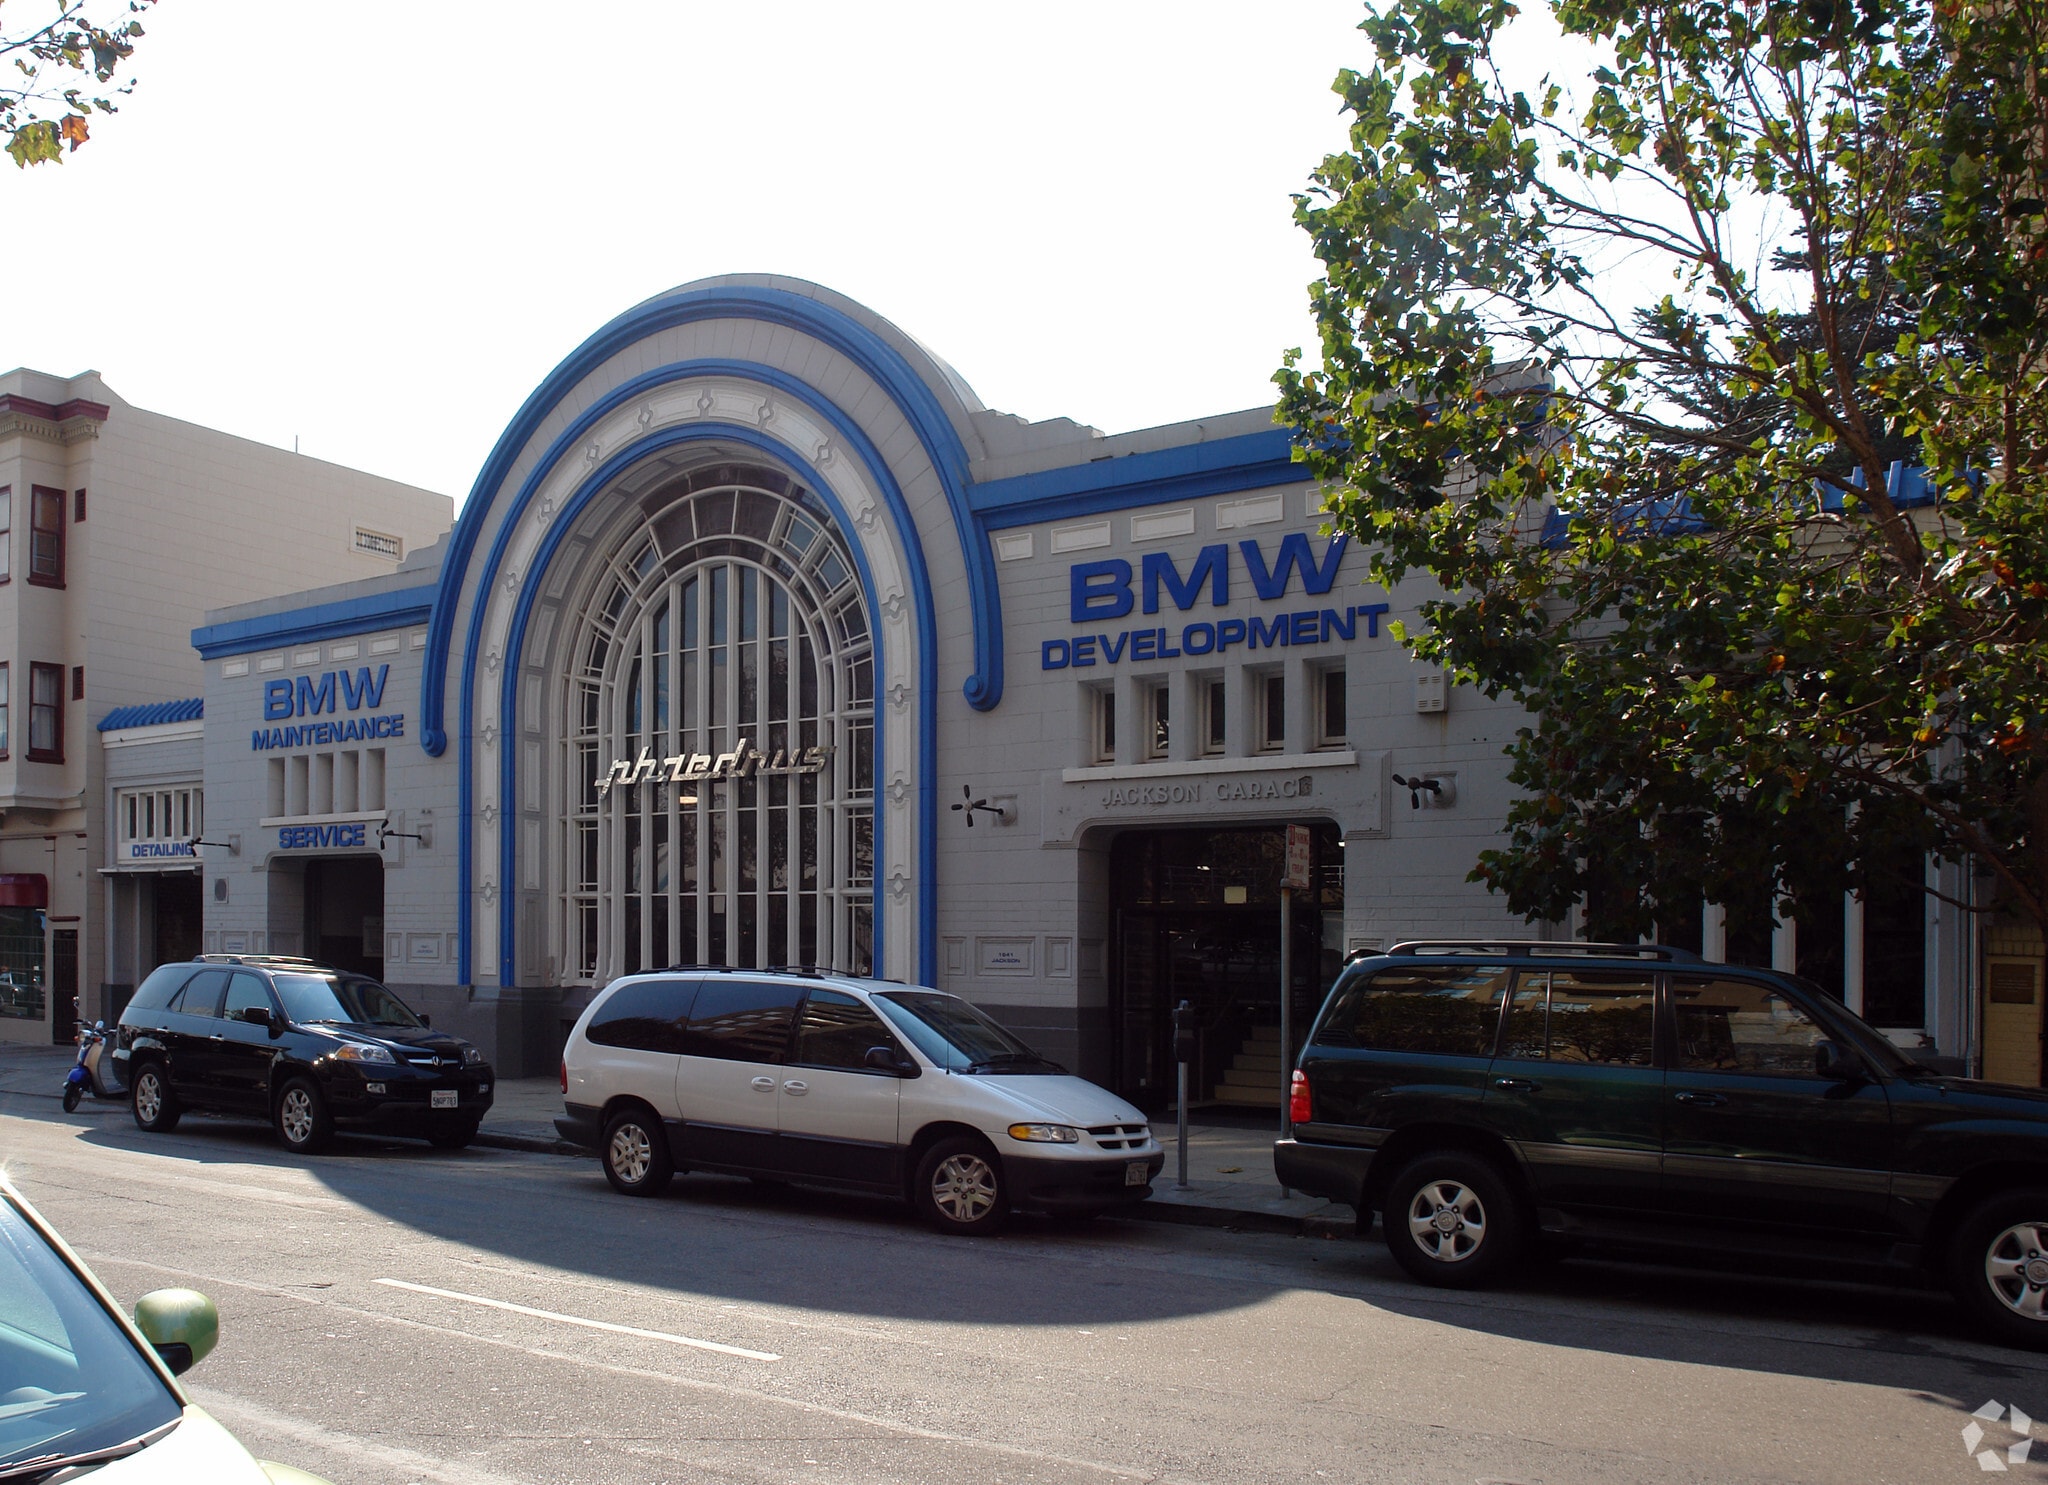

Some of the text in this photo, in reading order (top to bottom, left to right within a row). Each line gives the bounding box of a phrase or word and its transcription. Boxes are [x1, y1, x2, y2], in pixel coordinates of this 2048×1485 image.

[1070, 532, 1348, 623] BMW
[1041, 603, 1389, 670] DEVELOPMENT
[264, 663, 390, 721] BMW
[251, 714, 404, 751] MAINTENANCE
[1102, 776, 1312, 806] JACKSON GARAG
[132, 842, 193, 857] DETAILING
[279, 824, 366, 849] SERVICE
